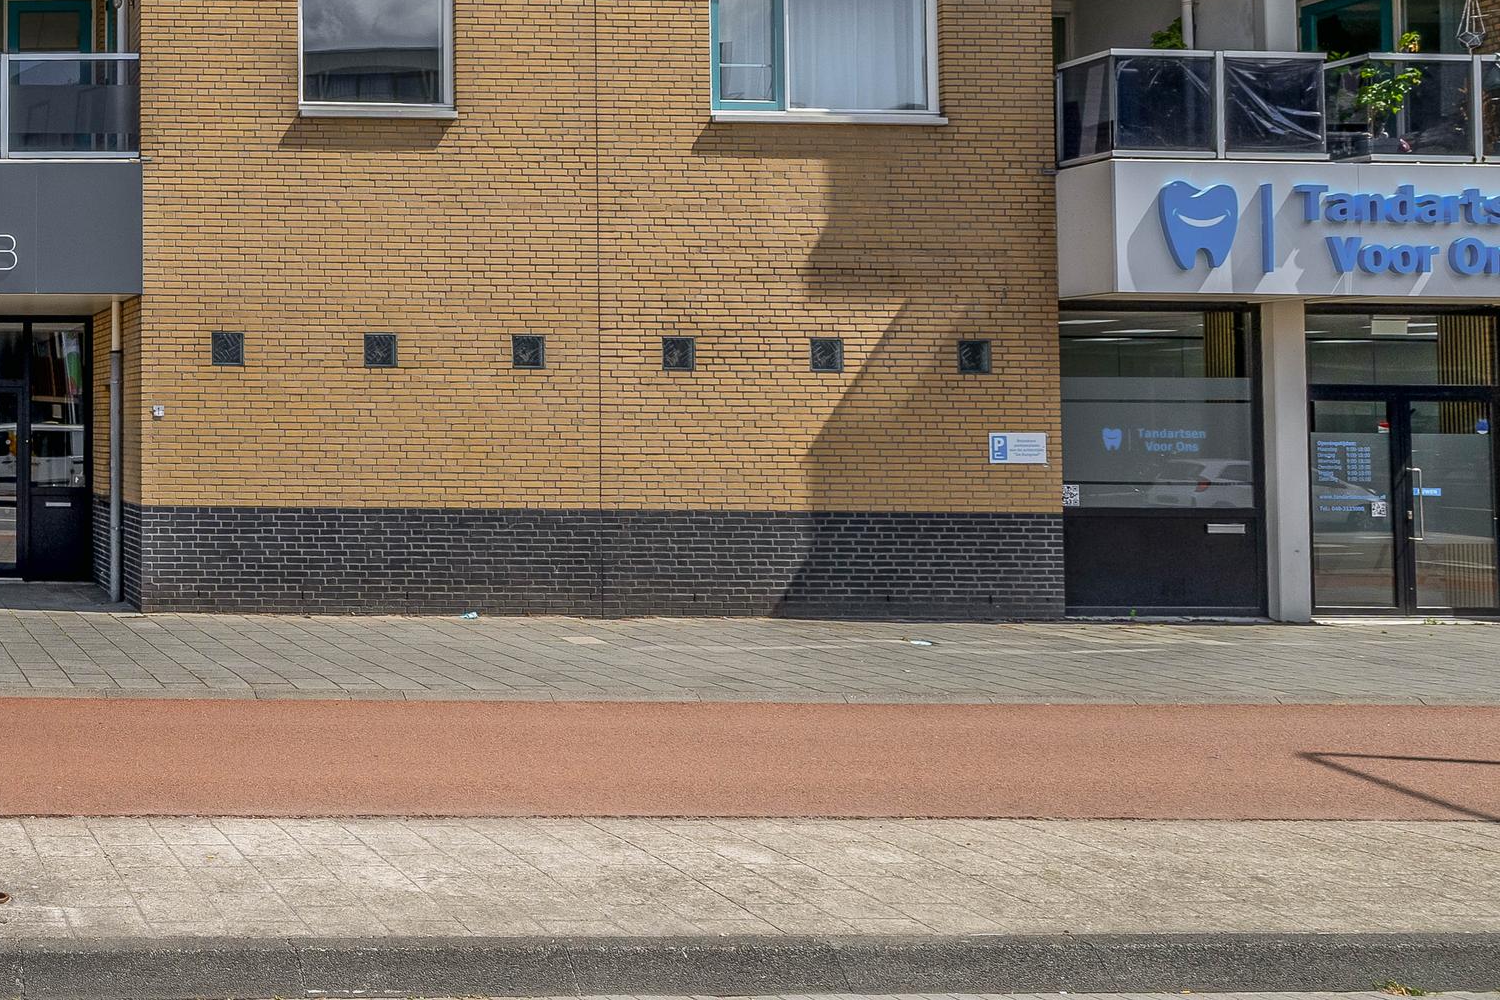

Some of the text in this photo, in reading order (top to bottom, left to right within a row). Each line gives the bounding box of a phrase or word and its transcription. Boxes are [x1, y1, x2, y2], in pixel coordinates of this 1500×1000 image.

[1325, 236, 1439, 274] Voor
[1138, 428, 1206, 439] Tandartsen
[1145, 441, 1199, 452] Voor Ons
